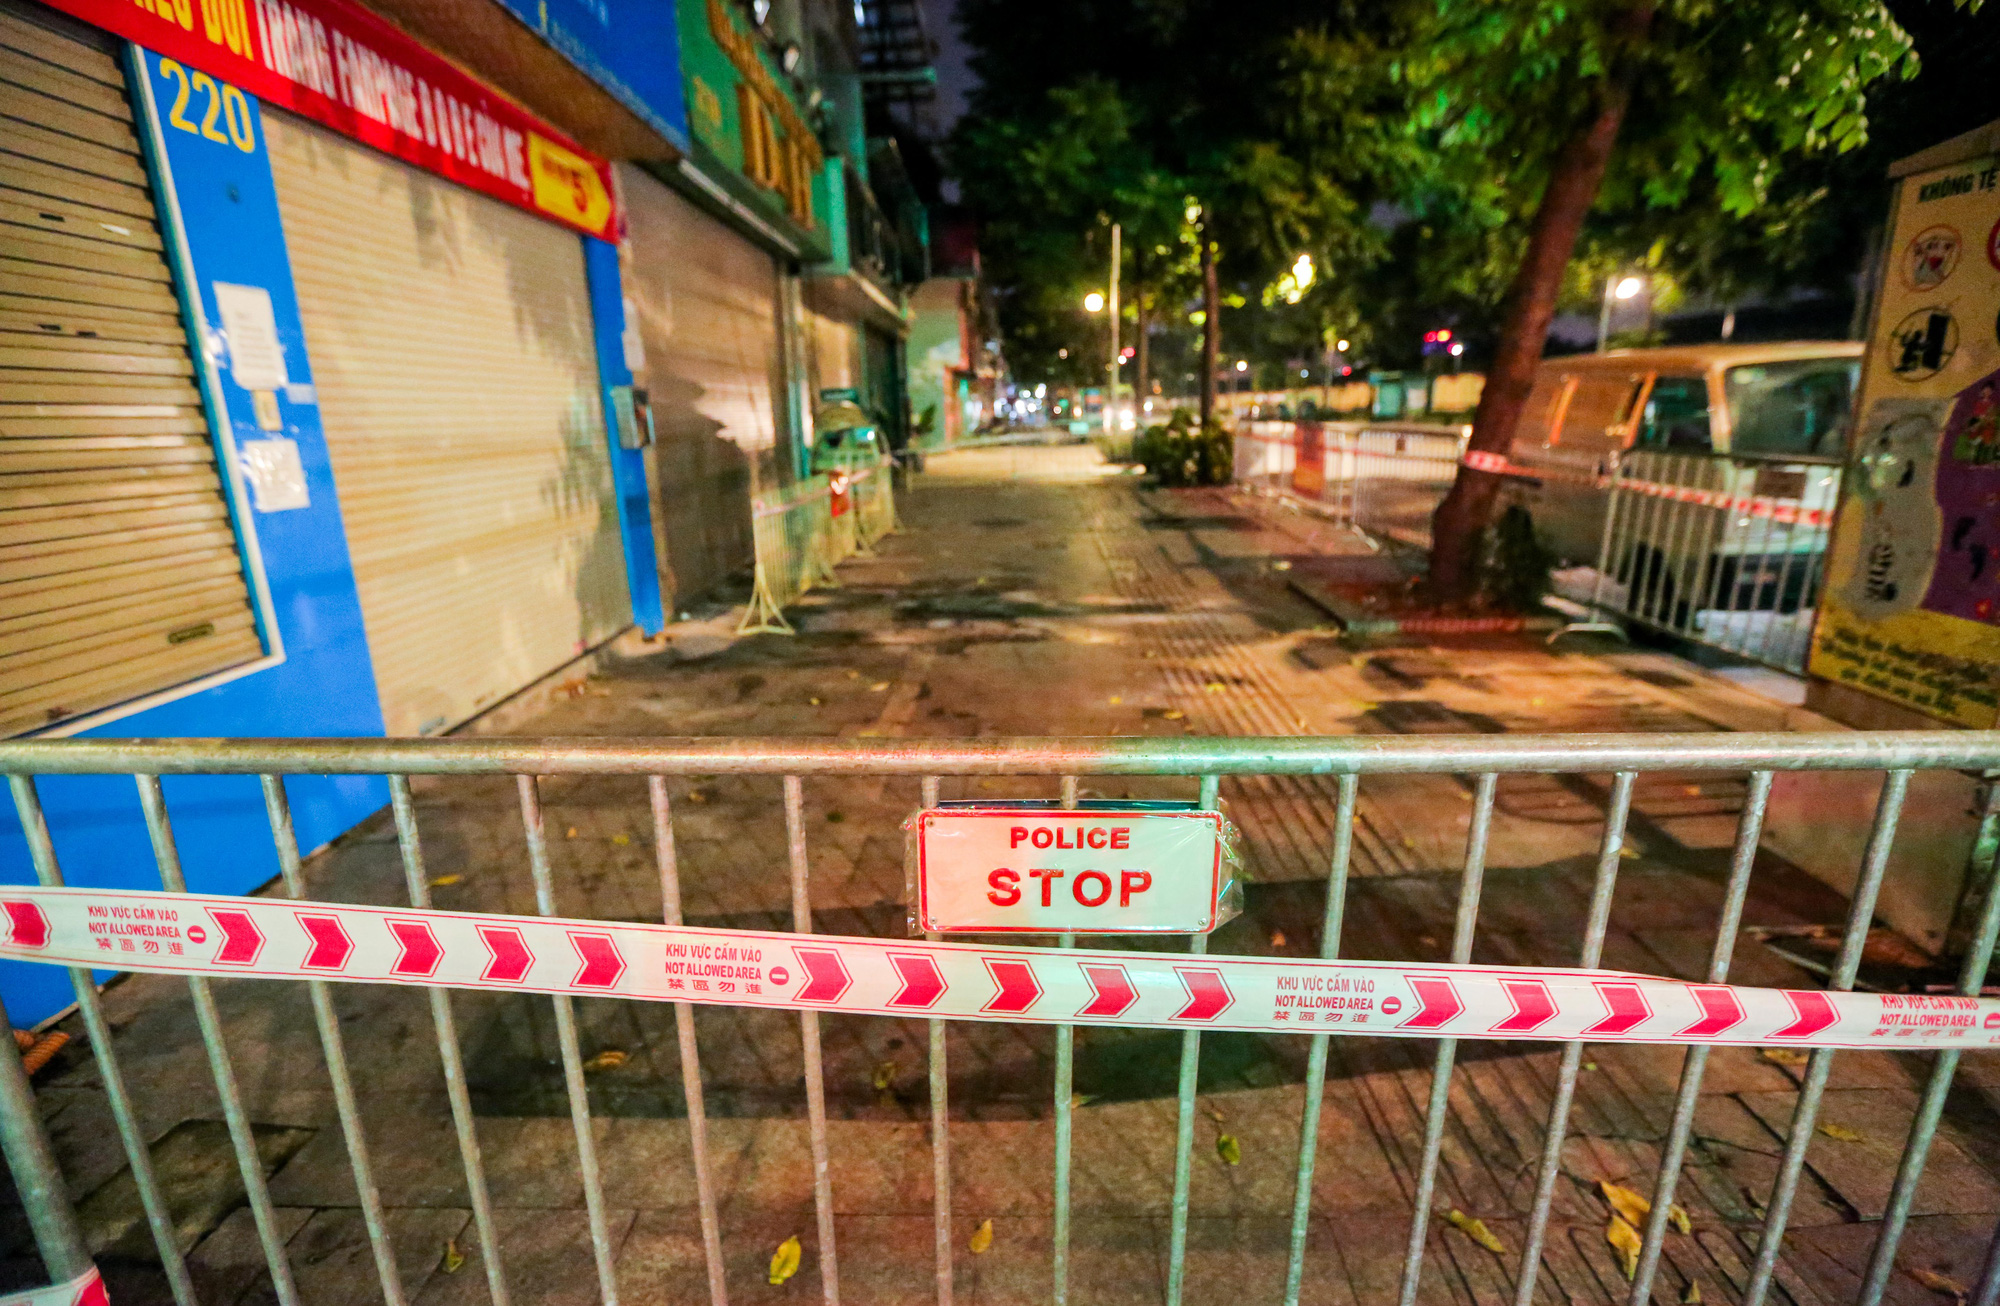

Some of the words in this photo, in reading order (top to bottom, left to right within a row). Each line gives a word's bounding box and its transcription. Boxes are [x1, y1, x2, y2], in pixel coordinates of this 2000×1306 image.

[160, 57, 255, 154] 220
[1010, 826, 1131, 850] POLICE
[986, 867, 1152, 908] STOP
[87, 905, 108, 918] KHU
[133, 903, 156, 920] CẤM
[88, 922, 107, 934] NOT
[109, 923, 155, 937] ALLOWED
[156, 926, 181, 938] AREA
[665, 943, 687, 957] KHU
[714, 942, 738, 960] CẤM
[665, 961, 685, 975] NOT
[686, 963, 734, 978] ALLOWED
[734, 966, 762, 980] AREA
[667, 978, 762, 994] 禁區勿進
[1277, 976, 1298, 990] KHU
[1326, 973, 1350, 992] CẤM
[1275, 995, 1296, 1007] NOT
[1296, 995, 1346, 1009] ALLOWED
[1346, 997, 1374, 1010] AREA
[1273, 1010, 1369, 1023] 禁區勿進
[1879, 1013, 1901, 1025] NOT
[1900, 1014, 1950, 1027] ALLOWED
[1949, 1015, 1976, 1027] AREA
